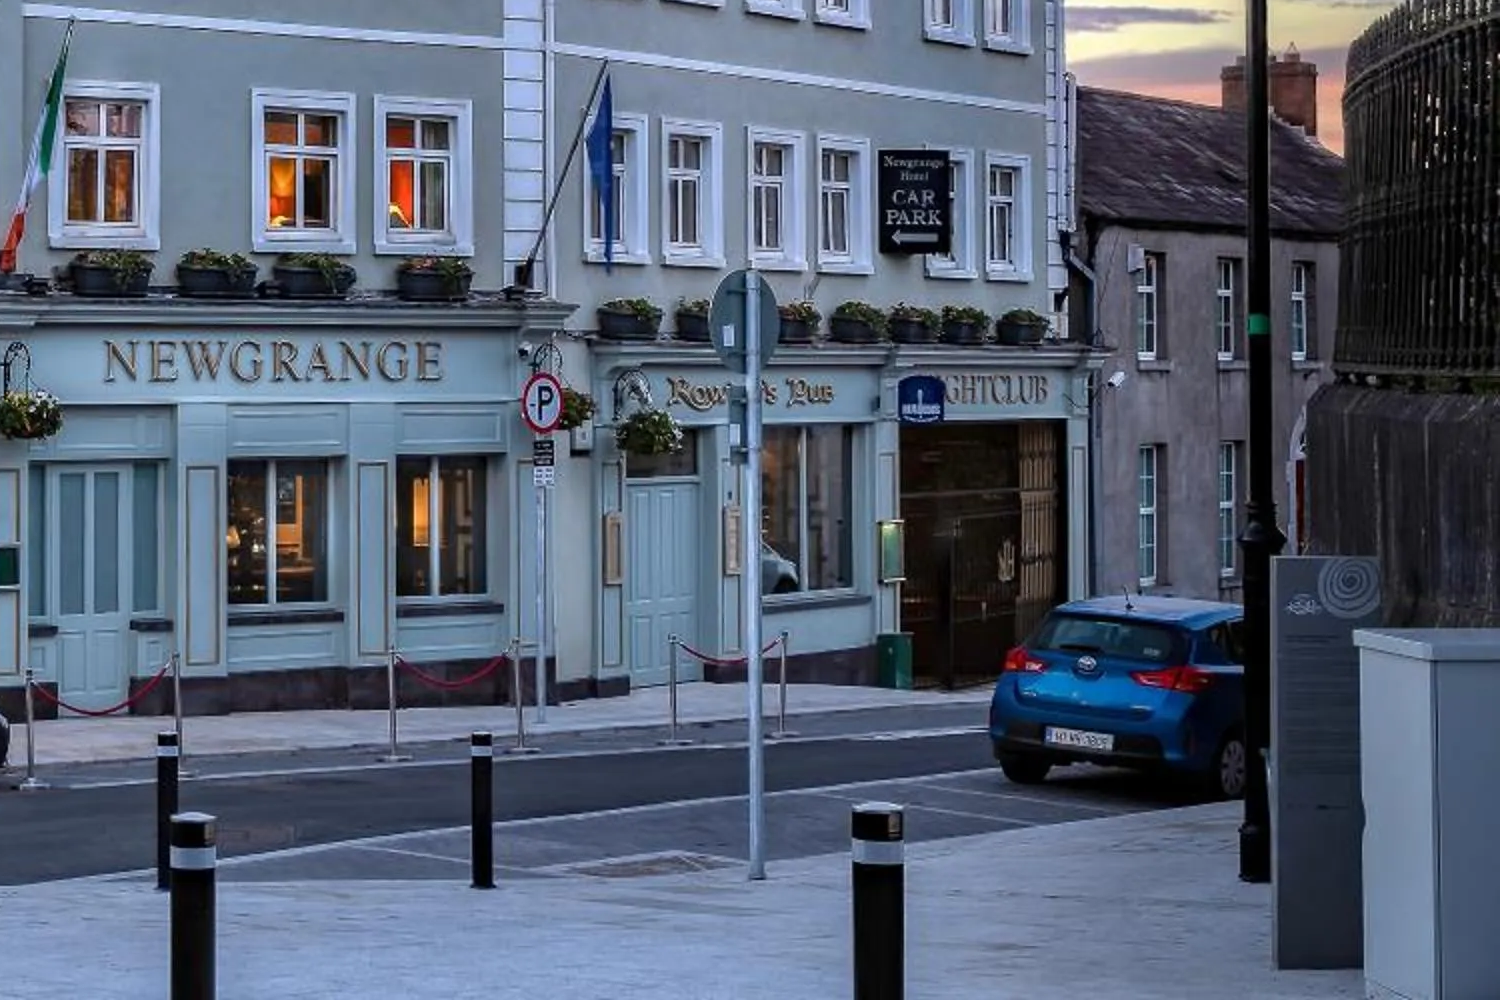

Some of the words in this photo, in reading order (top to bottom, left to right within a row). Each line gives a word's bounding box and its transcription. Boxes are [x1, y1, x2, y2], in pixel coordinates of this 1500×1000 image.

[892, 189, 936, 207] CAR
[885, 209, 943, 226] PARK
[102, 338, 446, 383] NEWGRANGE
[537, 385, 555, 421] P
[938, 374, 1049, 405] GHTCLUB
